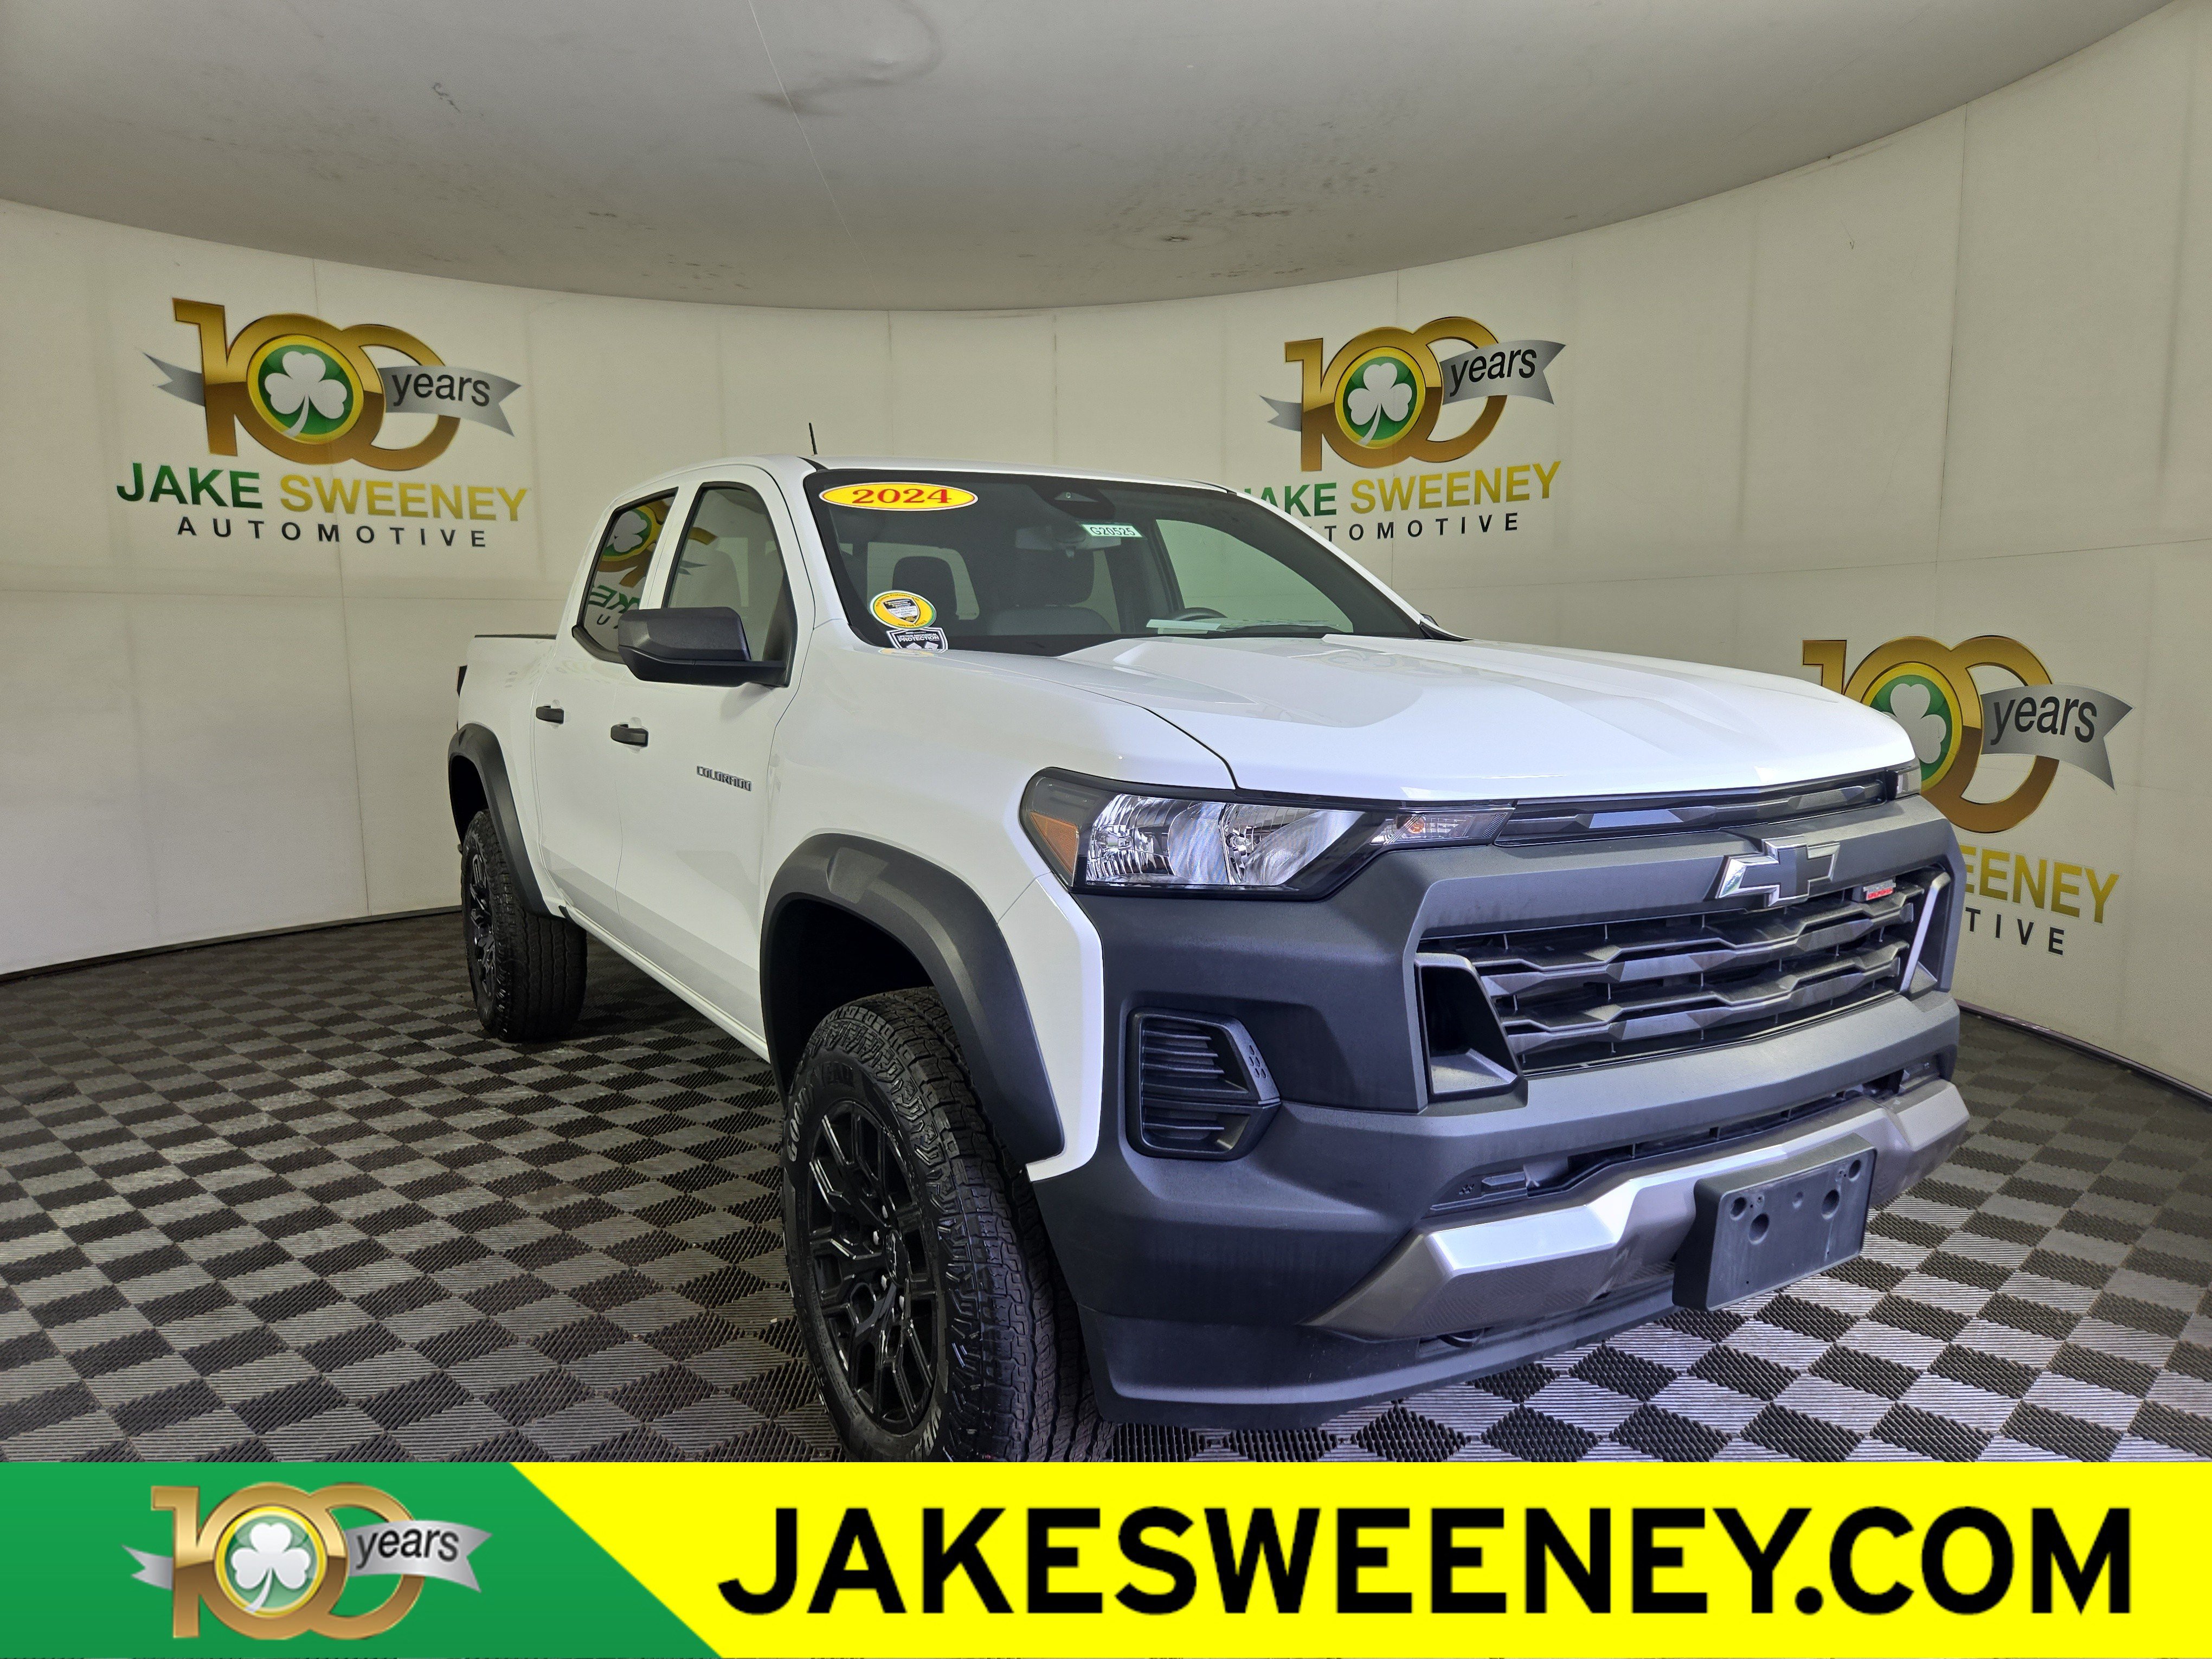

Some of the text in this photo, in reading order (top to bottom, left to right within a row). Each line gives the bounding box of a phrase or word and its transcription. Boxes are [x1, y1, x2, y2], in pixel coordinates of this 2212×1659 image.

[172, 298, 490, 471] 100 years
[1284, 316, 1536, 472] 100 years
[117, 462, 528, 522] JAKE SWEENEY
[852, 488, 952, 504] 2024
[1350, 461, 1561, 515] SWEENEY
[177, 517, 486, 548] AUTOMOTIVE
[1090, 526, 1135, 536] G20525
[1311, 512, 1518, 542] TOMOTIVE
[1990, 696, 2097, 745] years
[696, 765, 752, 792] COLORADO
